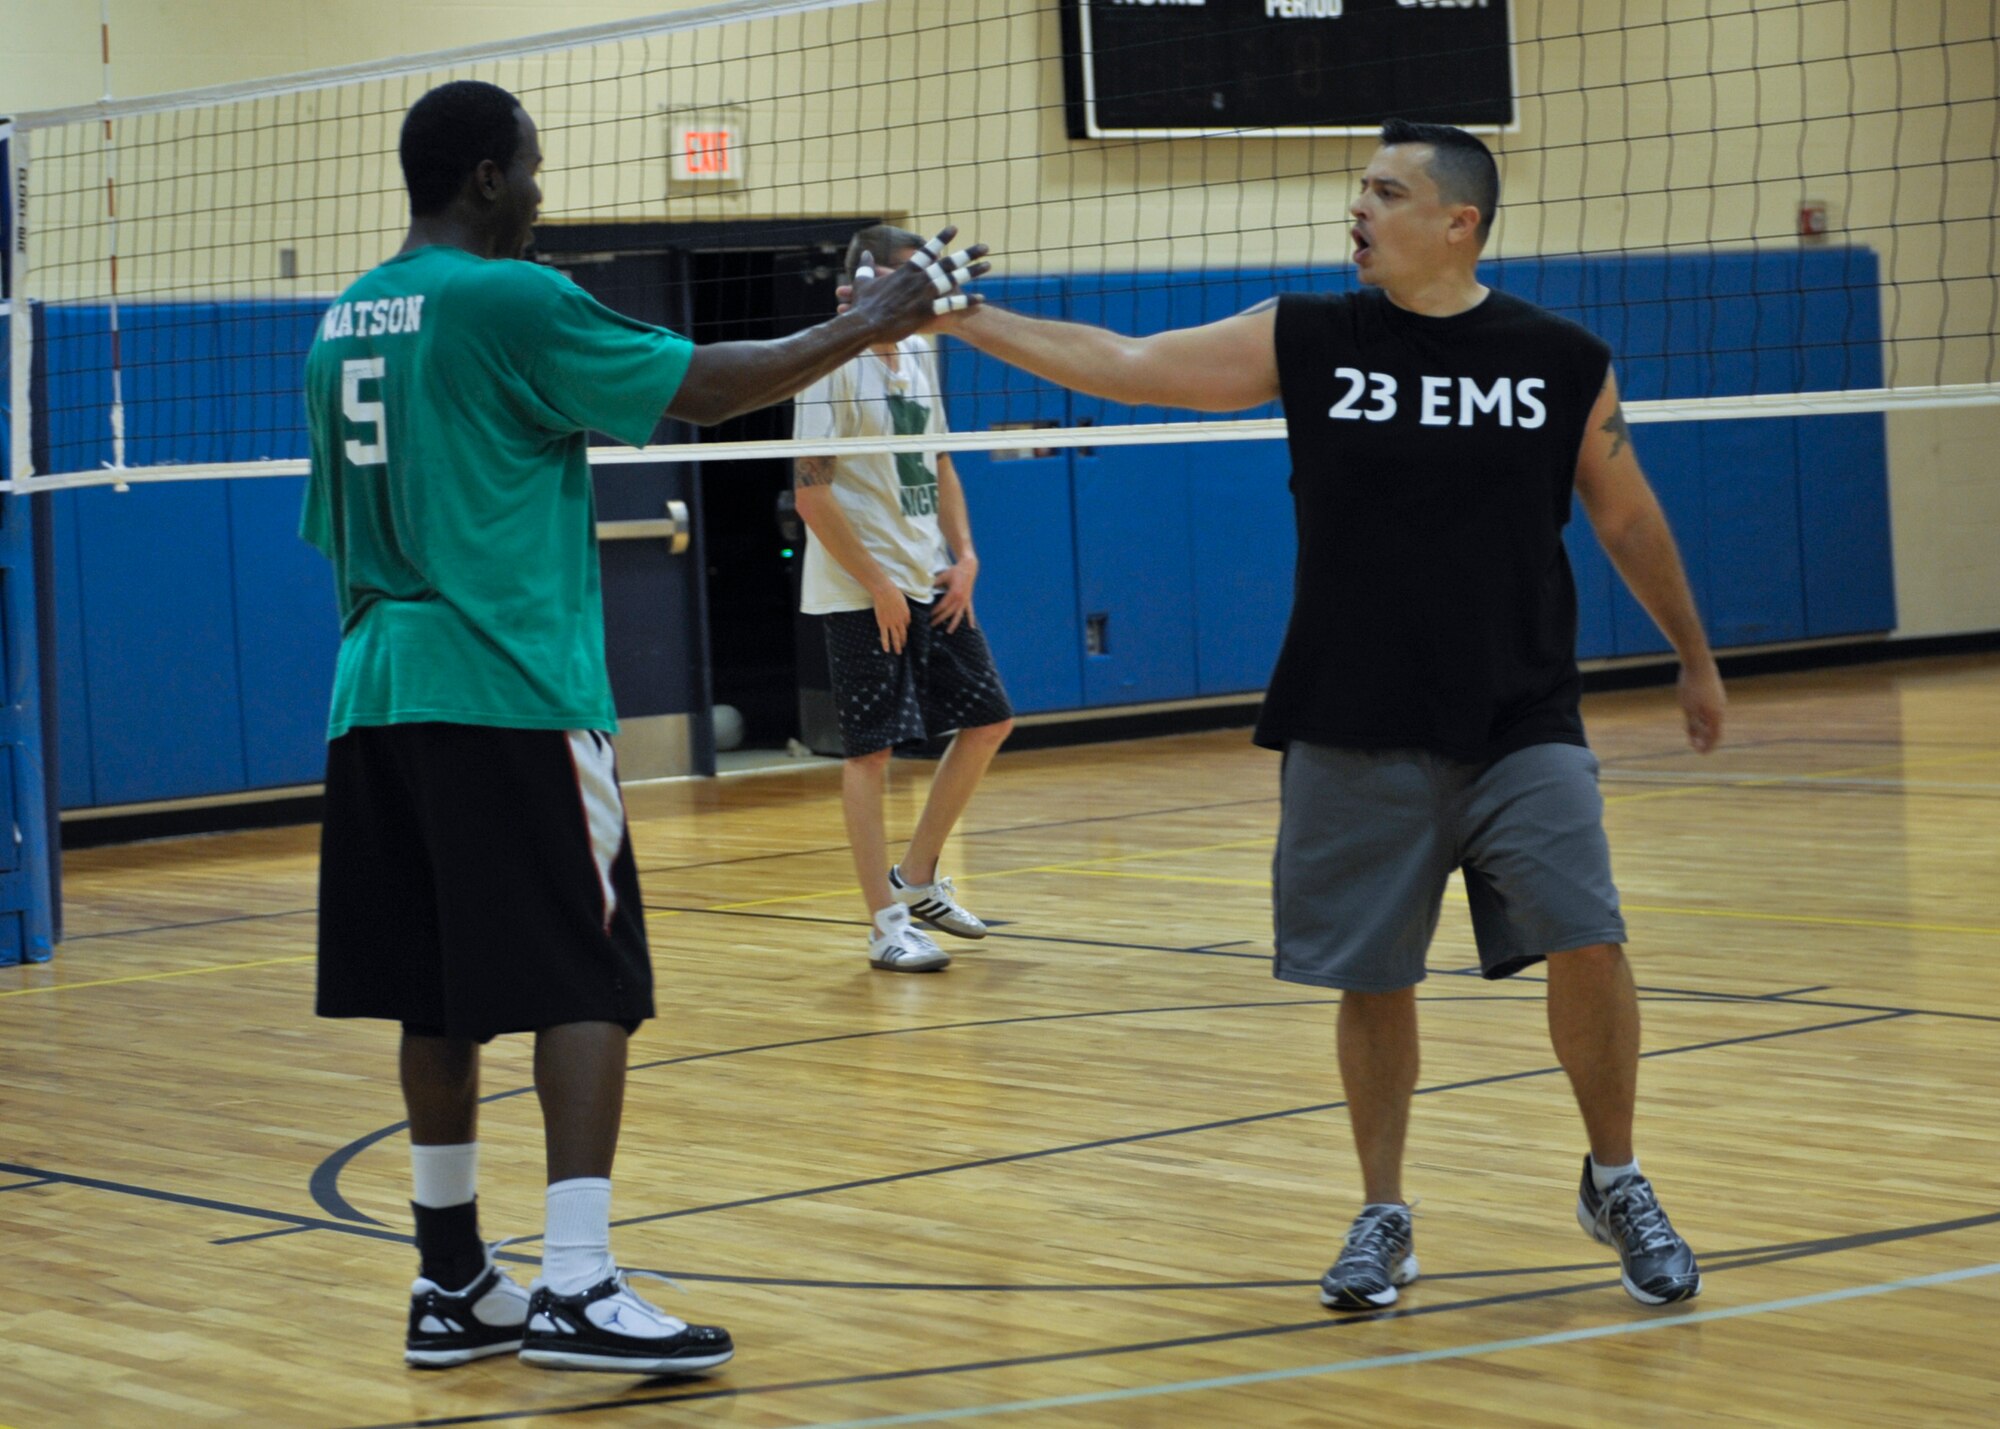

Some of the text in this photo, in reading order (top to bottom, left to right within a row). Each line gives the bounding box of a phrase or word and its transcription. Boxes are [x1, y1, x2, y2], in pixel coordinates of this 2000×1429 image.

[1265, 0, 1343, 18] PERIOD
[685, 131, 730, 173] EXIT
[323, 295, 425, 341] WATSON
[342, 357, 388, 466] 5
[1329, 367, 1547, 430] 23 EMS
